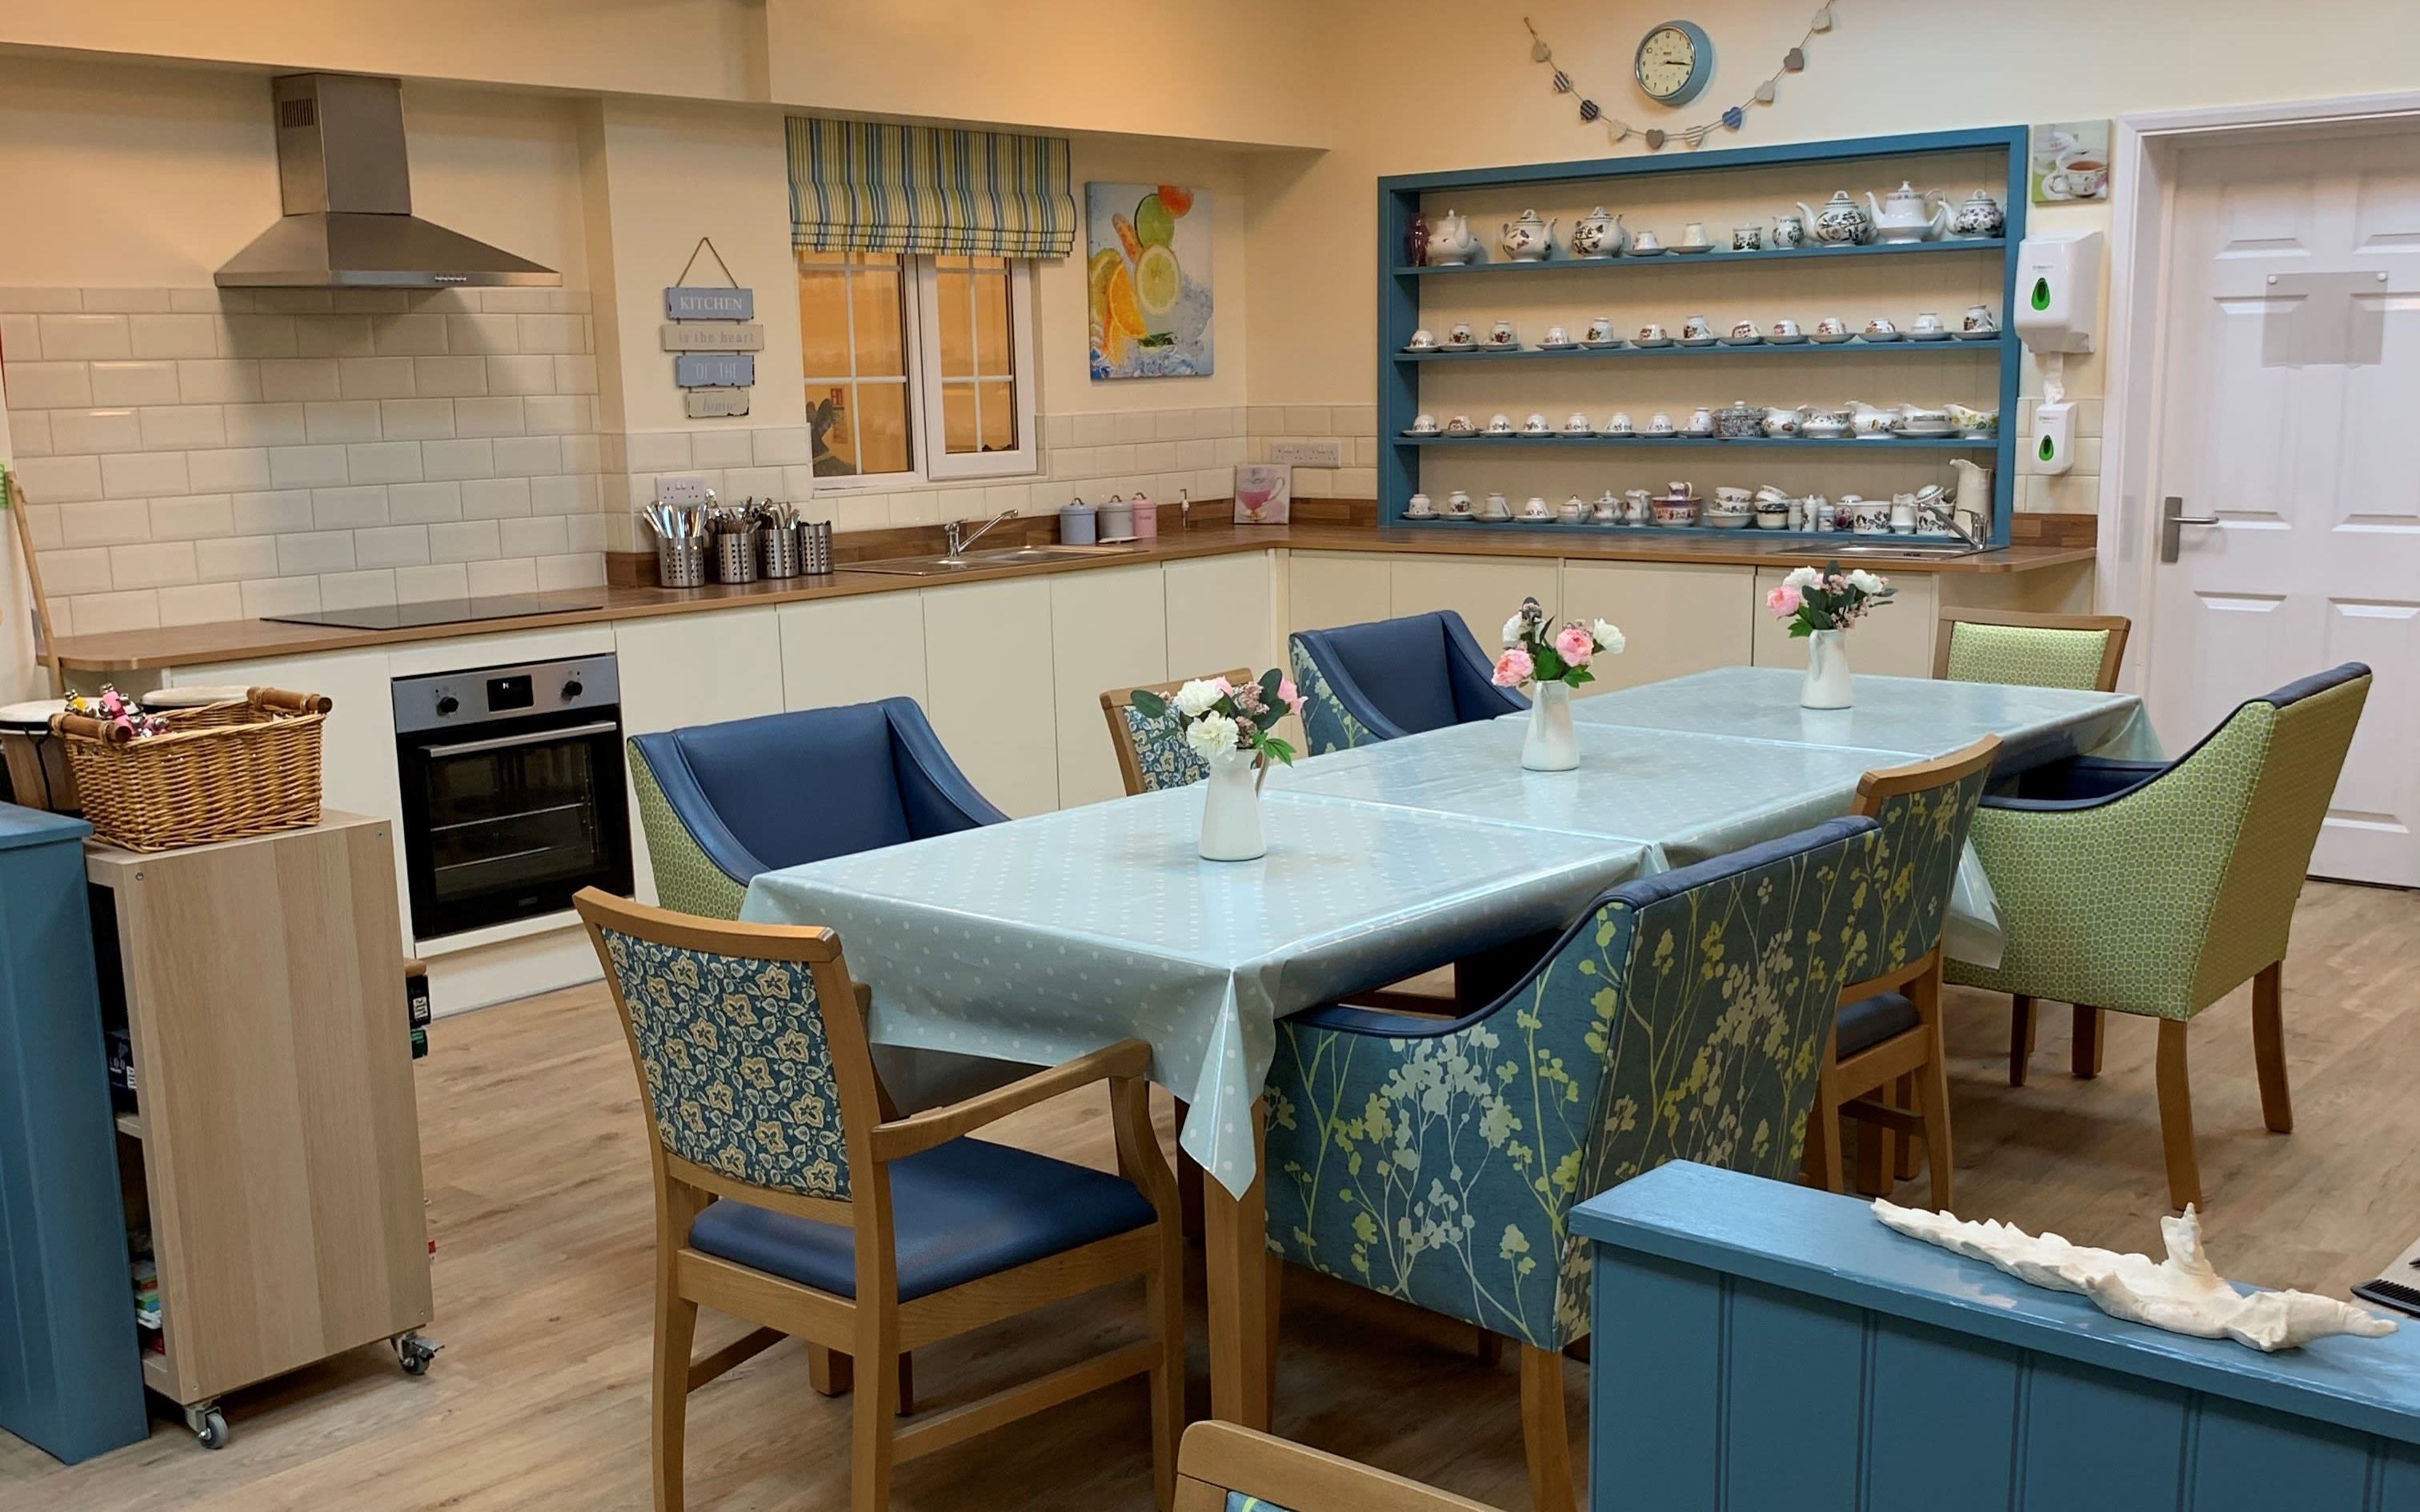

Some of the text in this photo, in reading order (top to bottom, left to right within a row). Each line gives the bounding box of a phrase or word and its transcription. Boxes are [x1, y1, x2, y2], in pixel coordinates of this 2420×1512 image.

[680, 297, 743, 310] KITCHEN
[679, 330, 753, 343] is the heart
